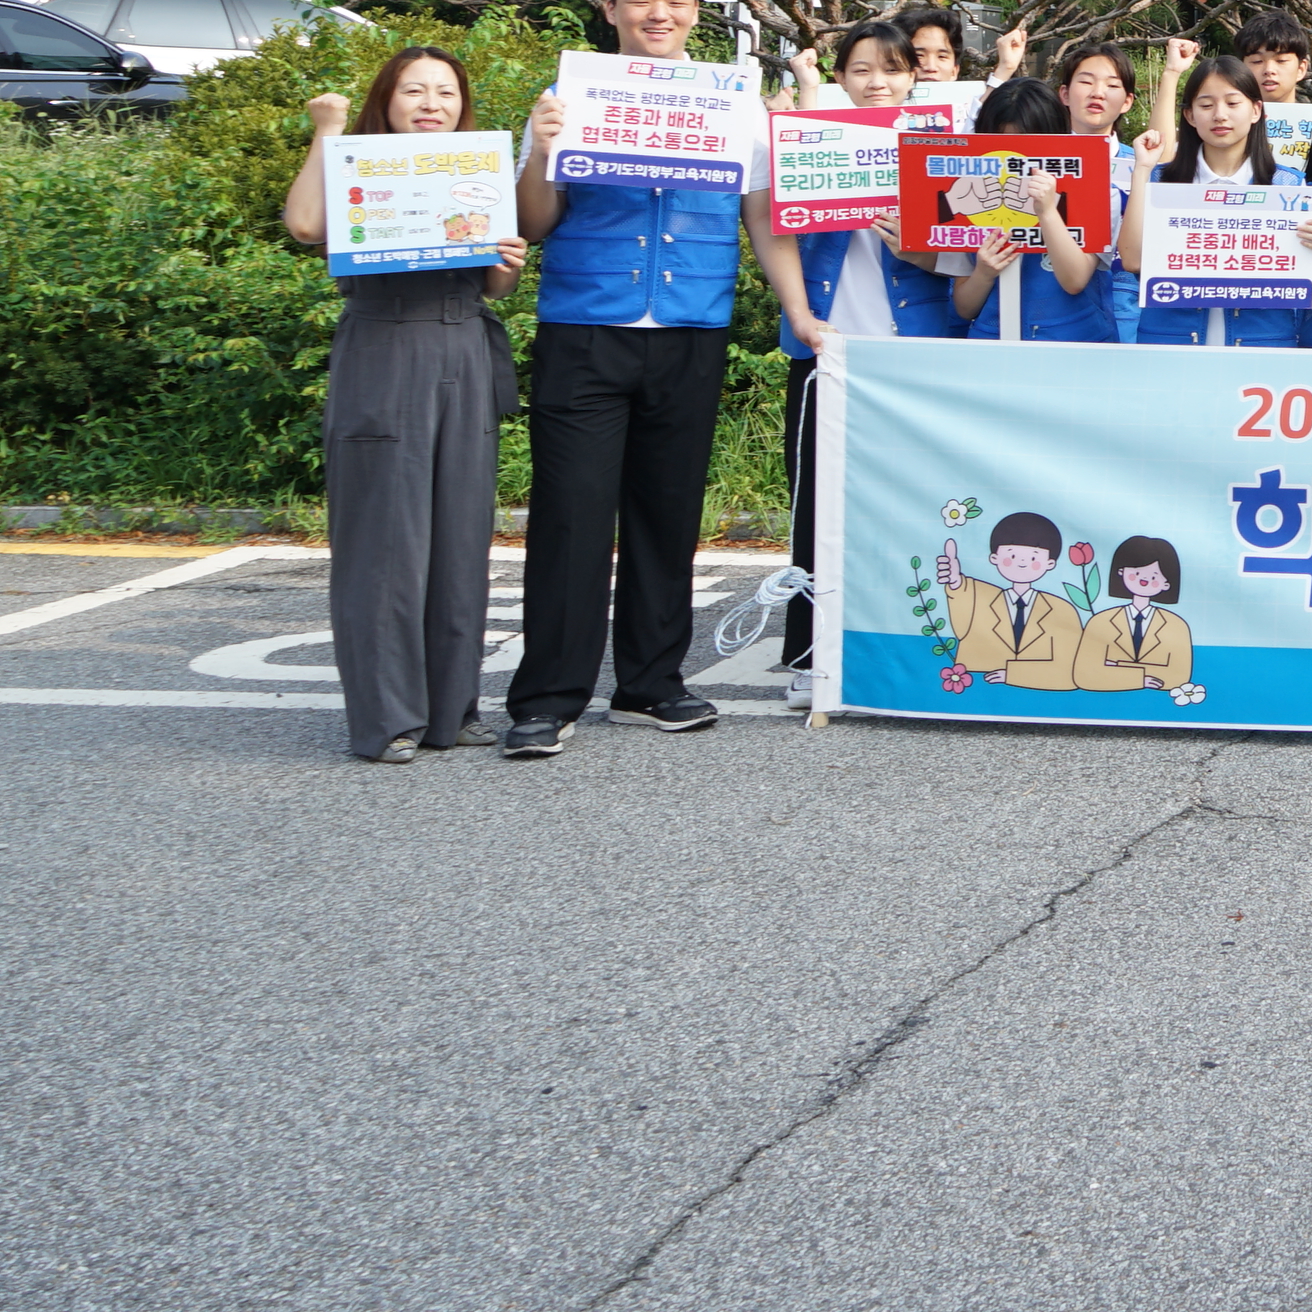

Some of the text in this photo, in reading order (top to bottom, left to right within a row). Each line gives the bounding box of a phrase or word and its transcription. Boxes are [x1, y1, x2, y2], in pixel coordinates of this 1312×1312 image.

[586, 88, 732, 111] 폭력없는 평화로운 학교는
[603, 105, 709, 130] 존중과 배려,
[1265, 119, 1293, 139] 없는
[581, 126, 727, 153] 협력적 소통으로!
[357, 151, 500, 177] 청소년 도박문제
[779, 150, 849, 169] 폭력없는
[928, 157, 1001, 177] 몰아내자
[595, 161, 738, 184] 경기도의정부교육지원청
[780, 173, 832, 192] 우리가
[836, 170, 871, 189] 함께
[1168, 216, 1299, 231] 폭력없는 평화로운 학교는
[1186, 233, 1280, 252] 존중과 배려,
[1167, 253, 1296, 271] 협력적 소통으로!
[1182, 286, 1308, 300] 경기도의정부교육지원청
